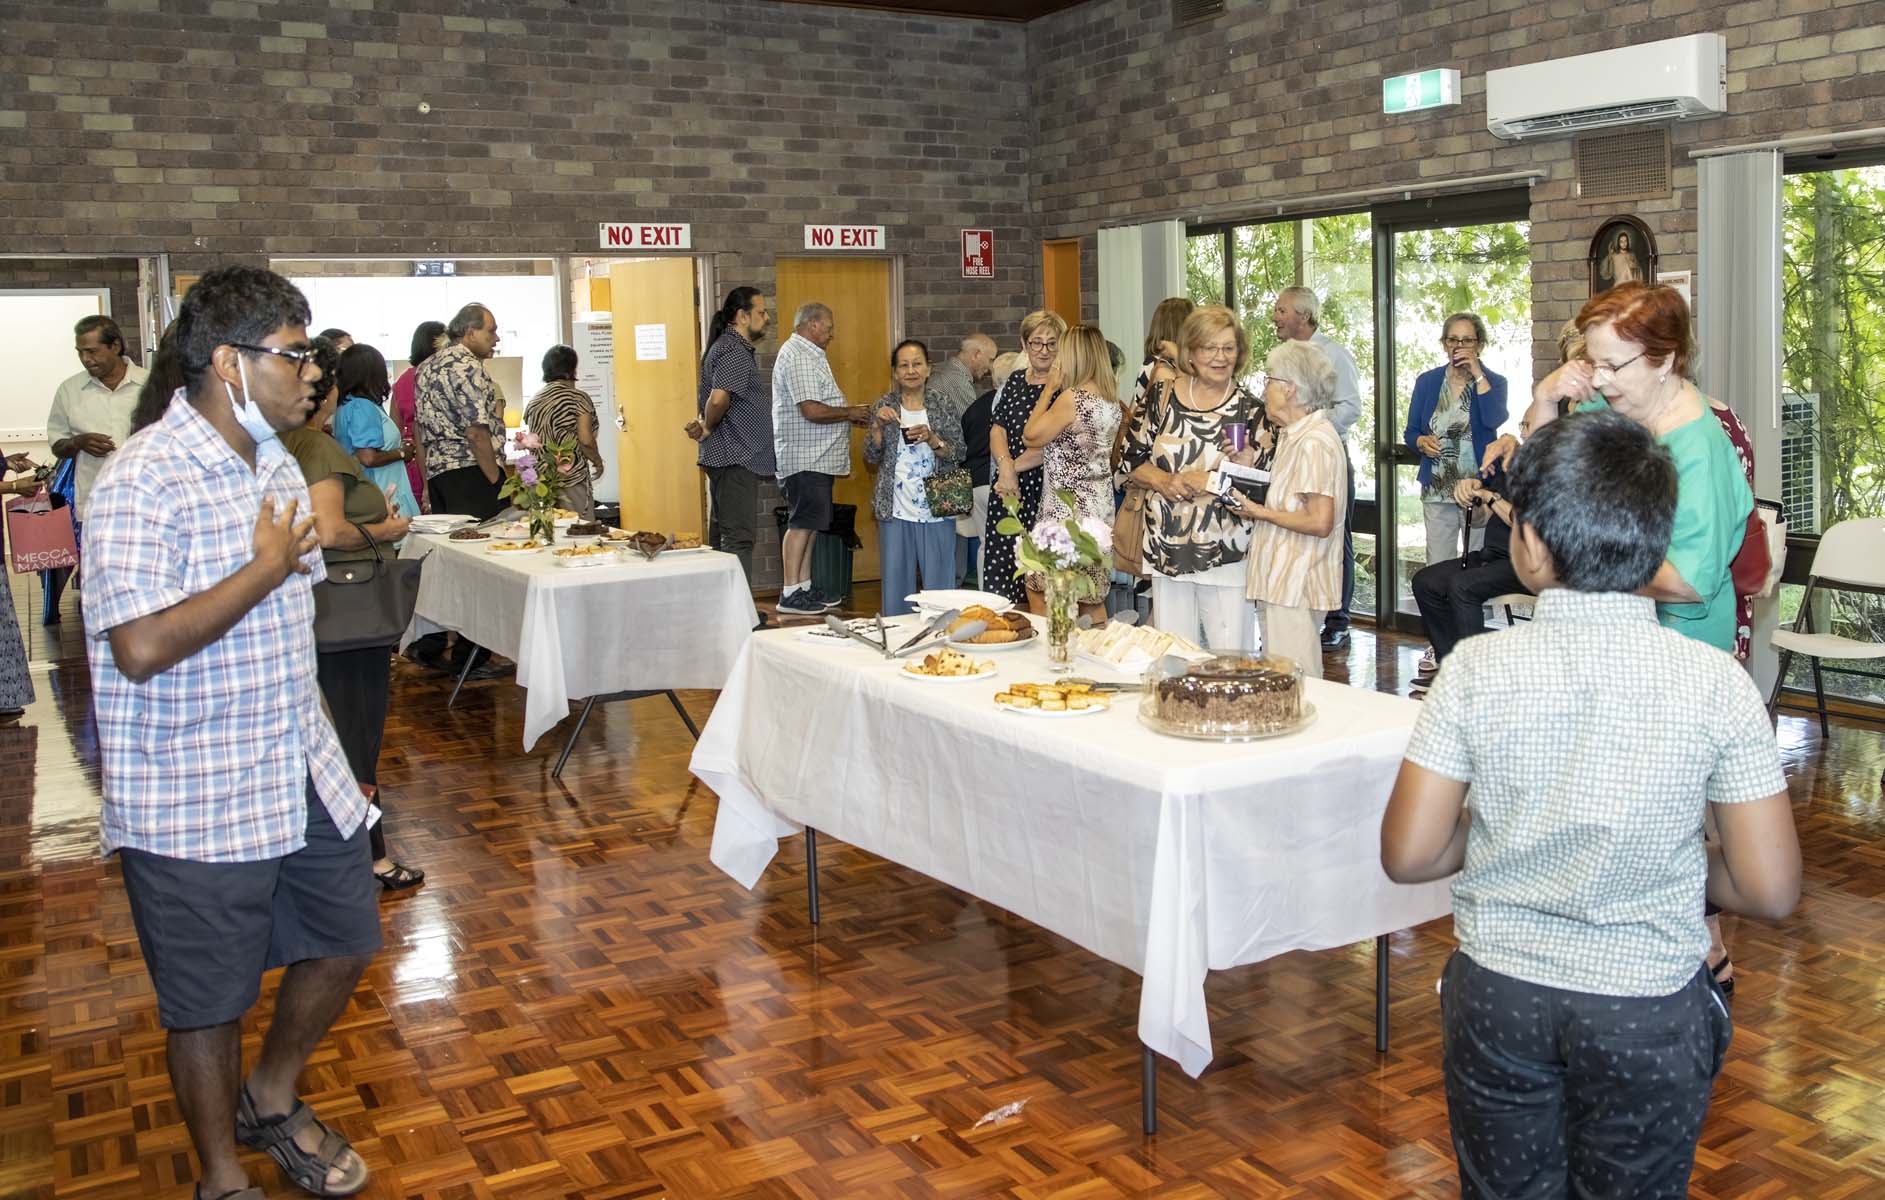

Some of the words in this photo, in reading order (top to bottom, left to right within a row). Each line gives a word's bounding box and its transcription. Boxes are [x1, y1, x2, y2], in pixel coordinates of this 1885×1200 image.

[608, 226, 633, 245] NO
[640, 226, 683, 245] EXIT
[812, 228, 834, 246] NO
[841, 228, 878, 247] EXIT
[972, 257, 984, 266] FIRE
[965, 266, 978, 275] HOSE
[979, 266, 991, 275] REEL
[16, 548, 70, 563] MECCA
[17, 555, 77, 572] MAXIMA
